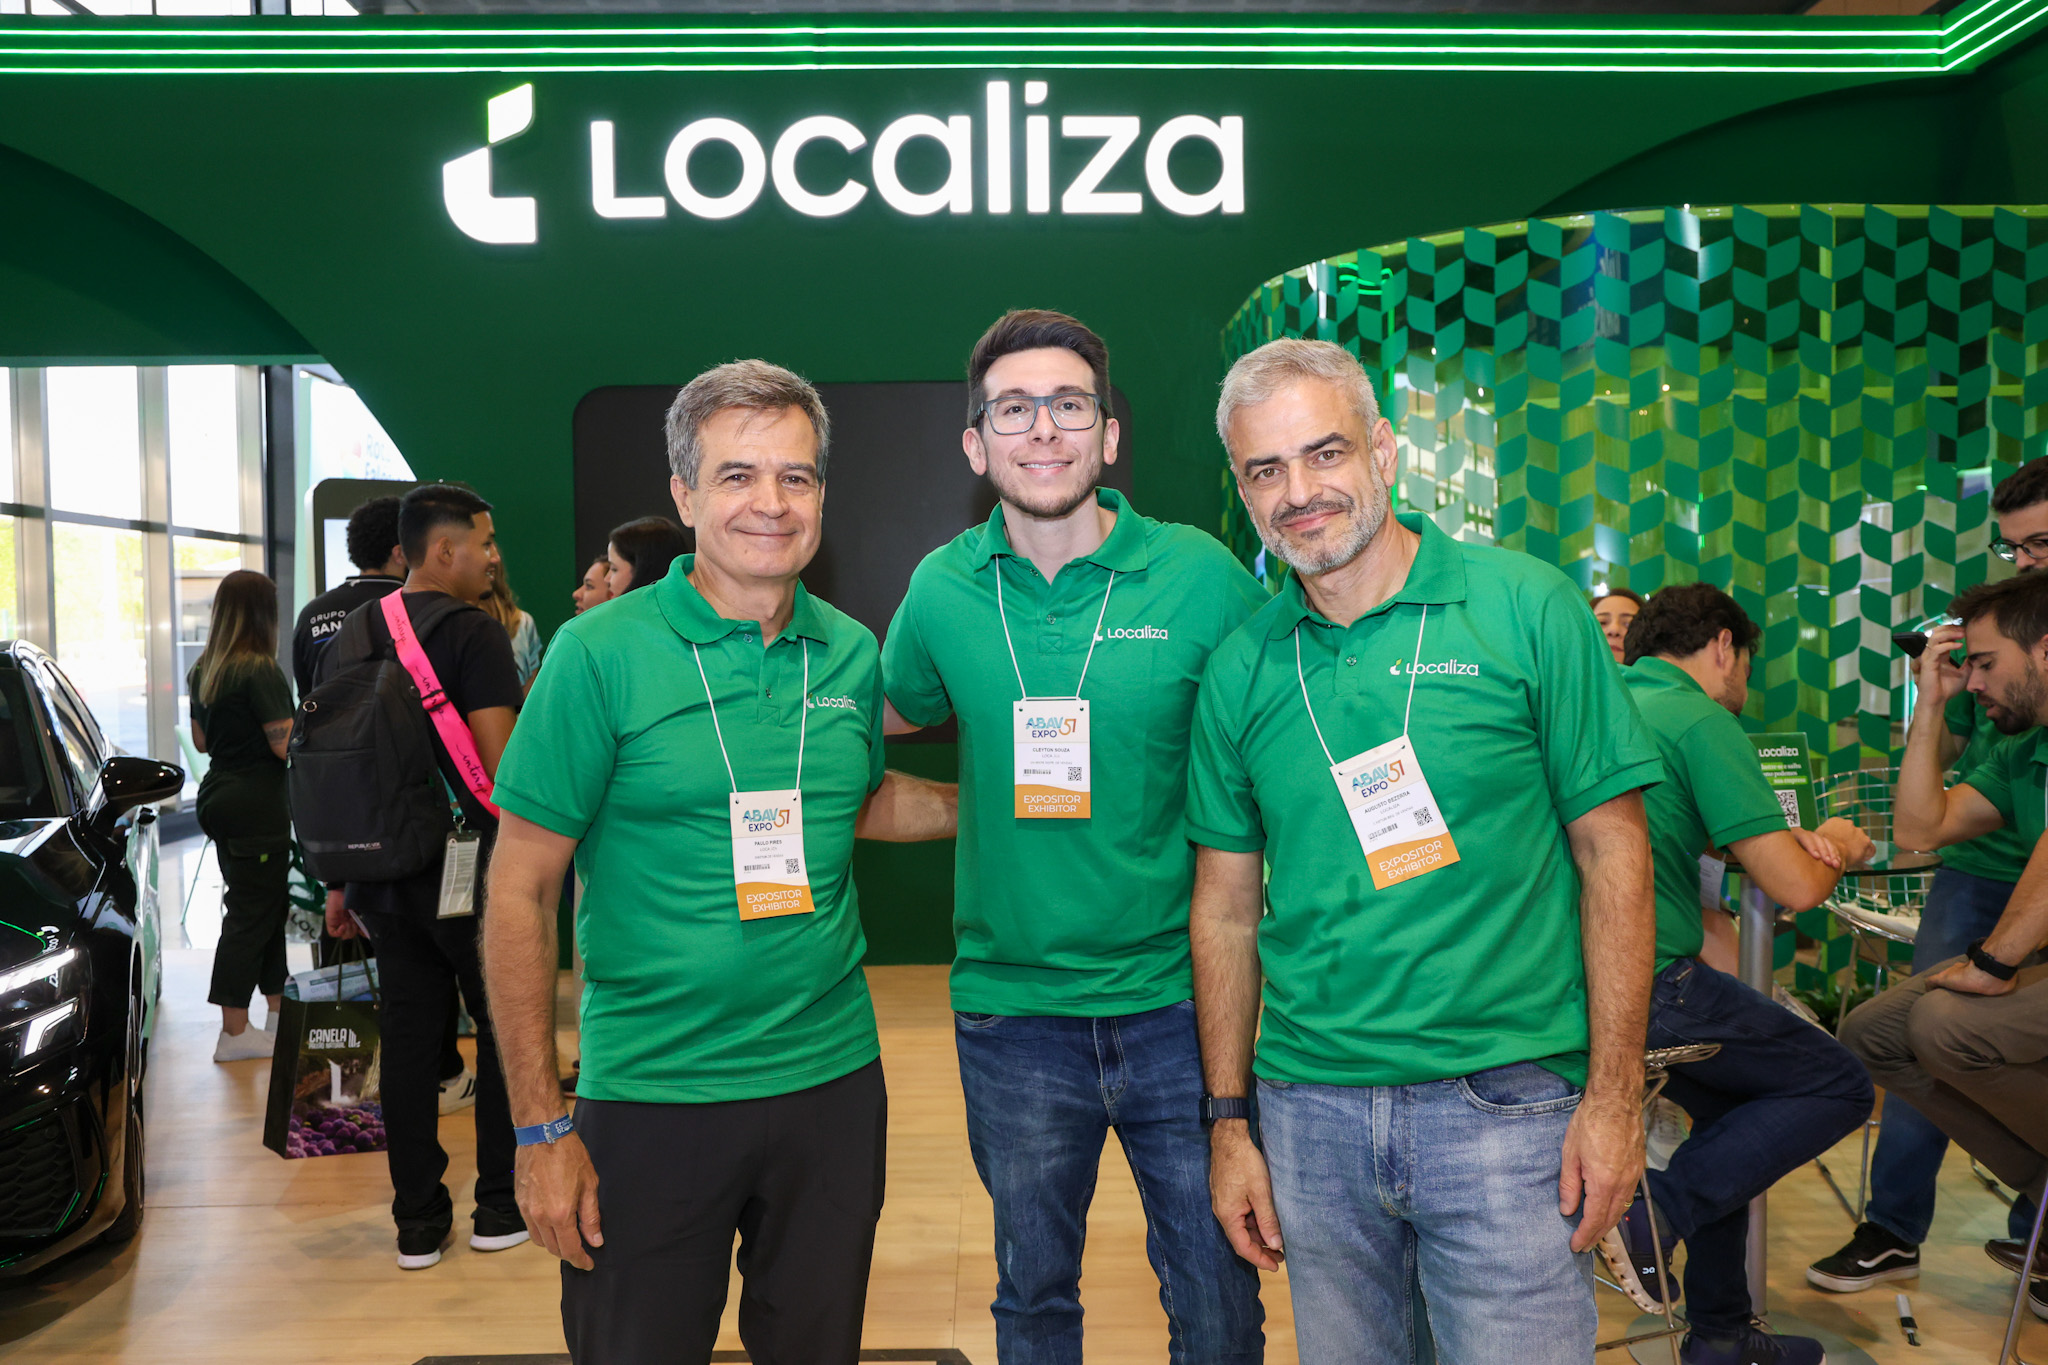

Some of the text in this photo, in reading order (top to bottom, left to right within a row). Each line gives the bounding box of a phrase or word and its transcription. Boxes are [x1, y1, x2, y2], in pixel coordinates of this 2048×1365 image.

[591, 79, 1245, 221] Localiza
[310, 610, 347, 624] GRUPO
[1107, 625, 1169, 640] Localiza
[1405, 658, 1479, 677] Localiza
[1031, 729, 1058, 738] EXPO
[1758, 745, 1799, 757] Localiza
[1361, 780, 1388, 798] EXPO
[1023, 794, 1082, 804] EXPOSITOR
[1028, 804, 1077, 813] EXHIBITOR
[748, 822, 773, 832] EXPO
[1378, 840, 1444, 872] EXPOSITOR
[1387, 852, 1443, 880] EXHIBITOR
[746, 889, 803, 904] EXPOSITOR
[752, 899, 801, 913] EXHIBITOR
[308, 1027, 347, 1043] CANELA
